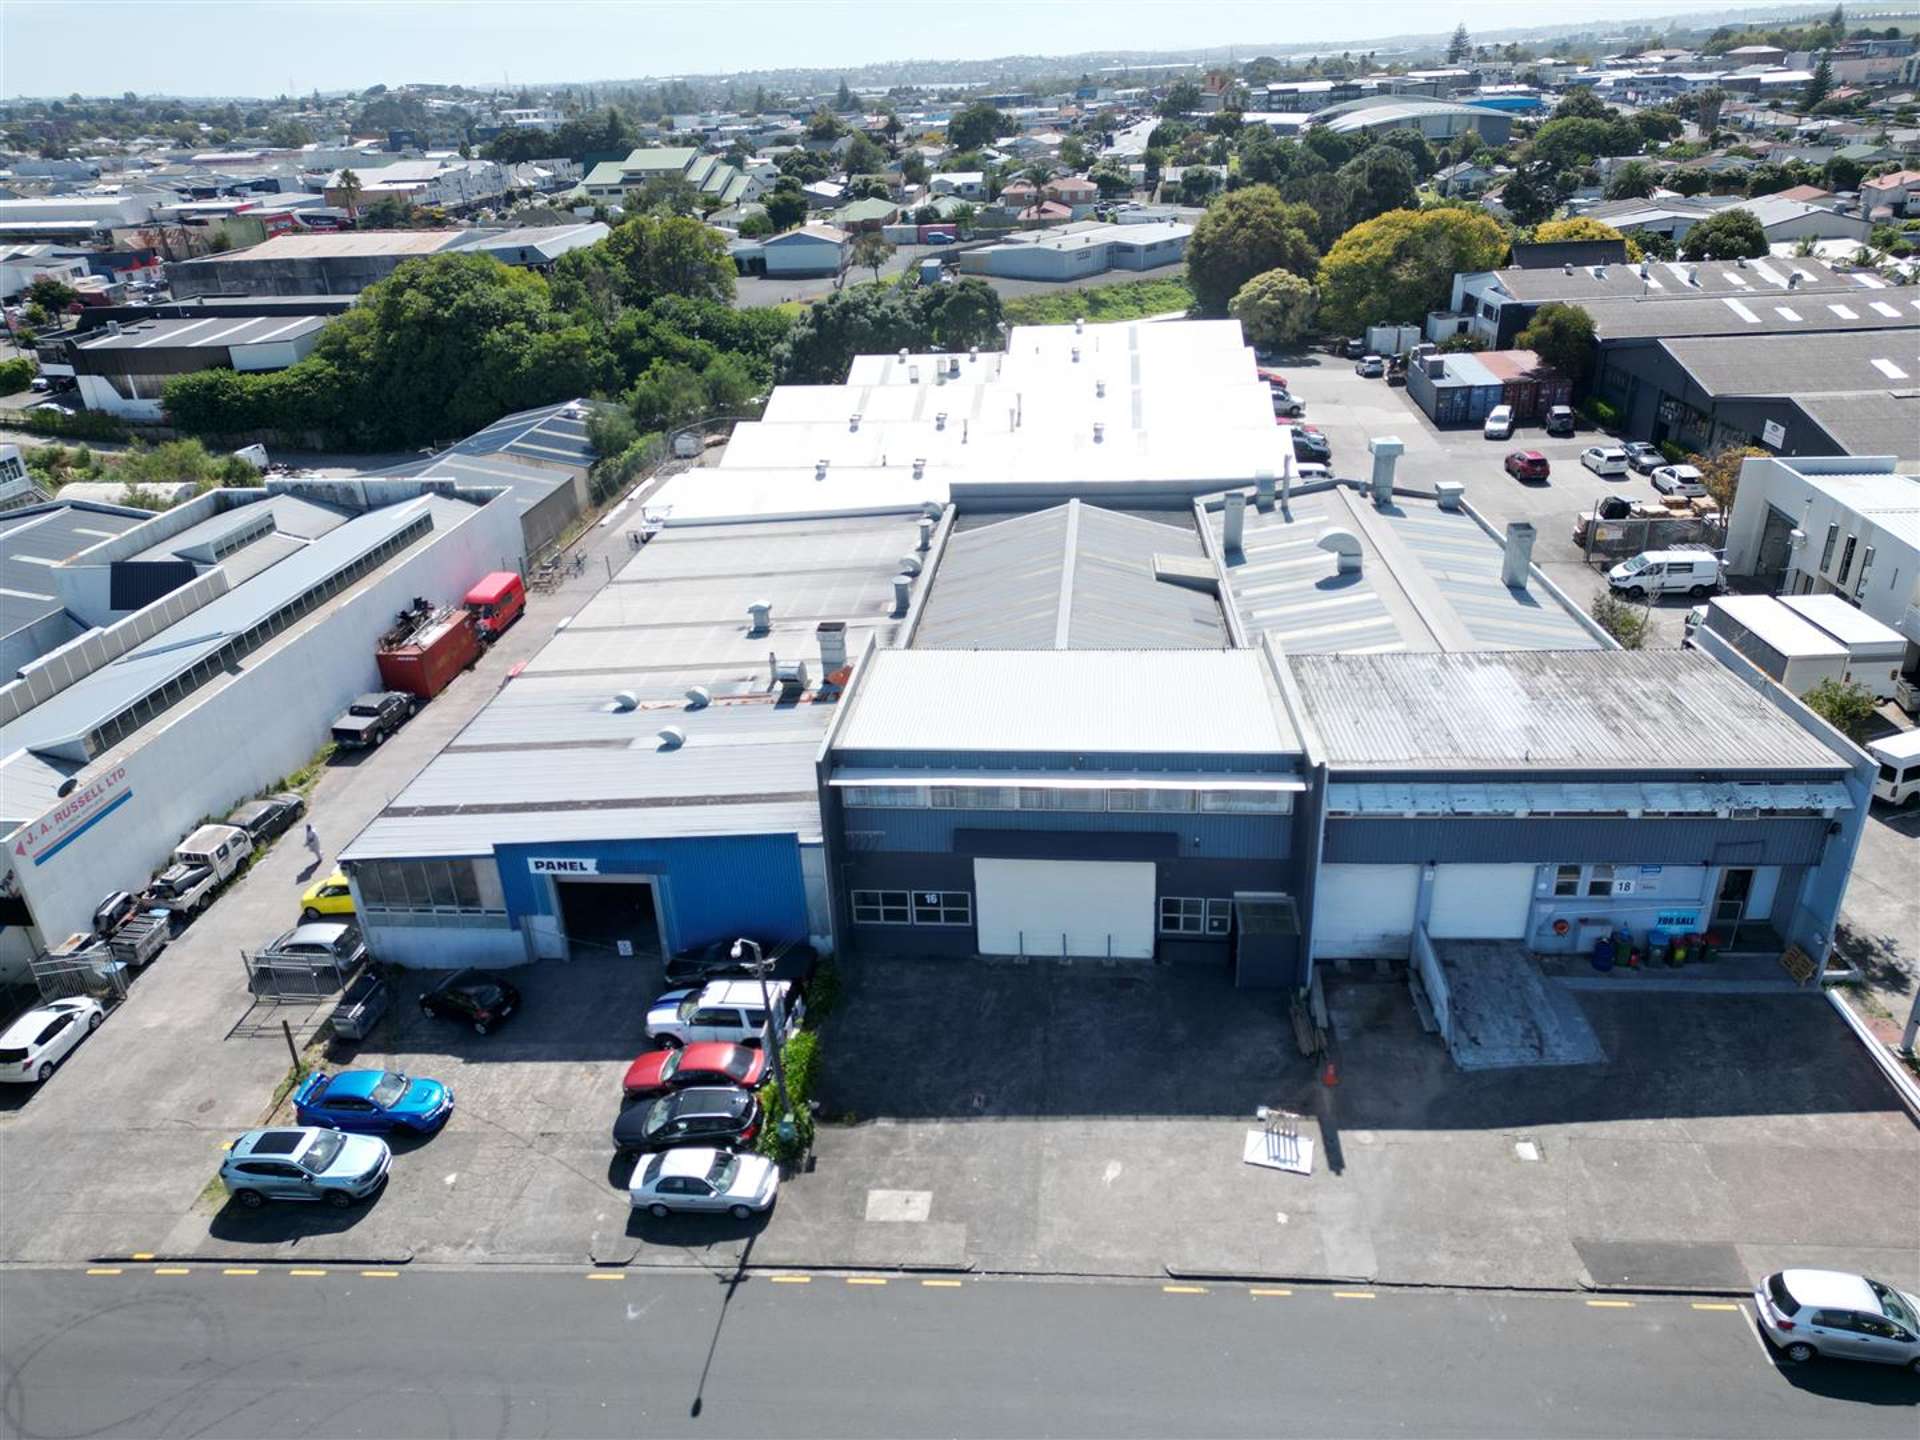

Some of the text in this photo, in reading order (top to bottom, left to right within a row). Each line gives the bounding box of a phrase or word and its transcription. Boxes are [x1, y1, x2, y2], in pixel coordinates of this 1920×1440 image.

[54, 783, 105, 824] RUSSELL
[105, 767, 126, 787] LTD
[534, 860, 588, 872] PANEL
[1618, 881, 1632, 893] 18
[925, 894, 937, 904] 16
[1657, 916, 1695, 926] FOR SALE
